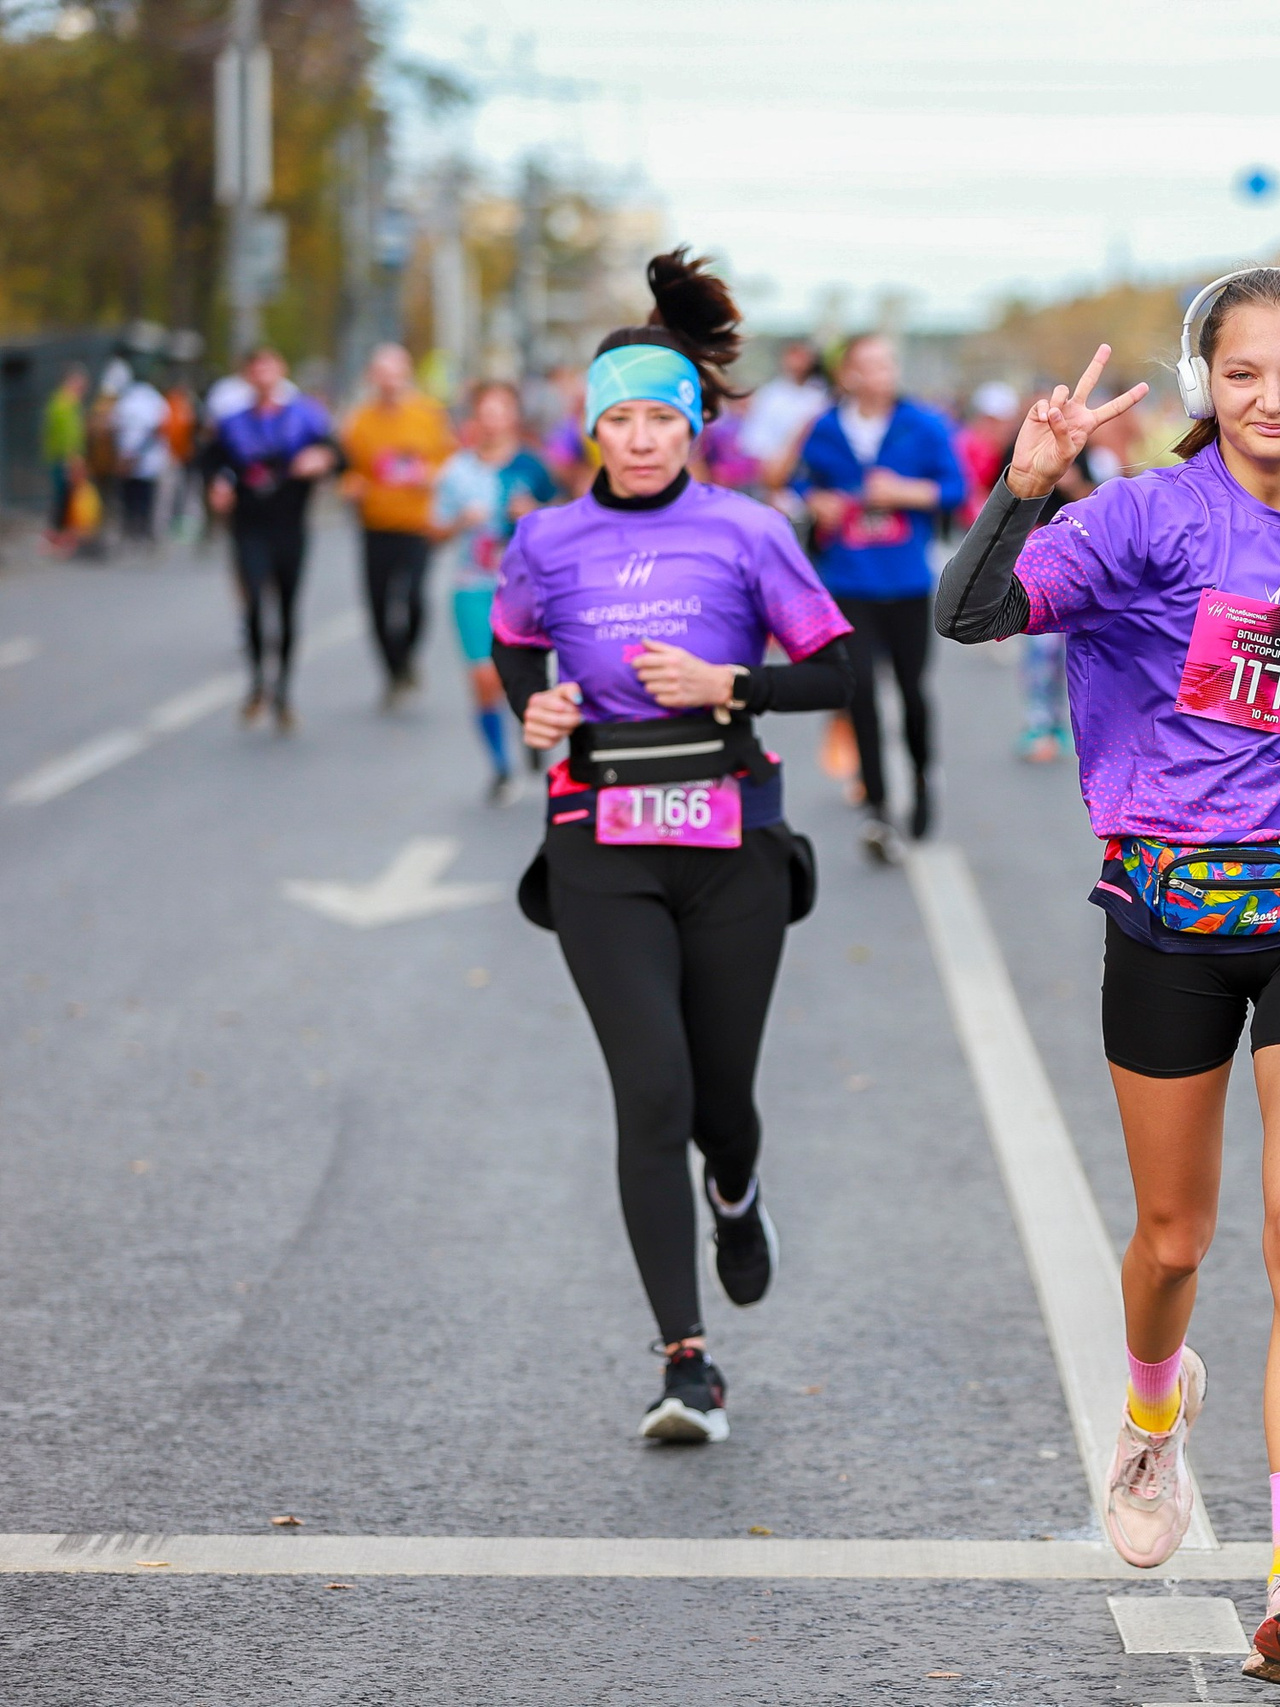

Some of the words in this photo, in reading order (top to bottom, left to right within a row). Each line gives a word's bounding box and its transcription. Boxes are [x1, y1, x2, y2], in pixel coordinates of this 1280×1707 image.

[1231, 640, 1239, 650] В
[1237, 629, 1273, 645] ВПИШИ
[1251, 708, 1262, 720] 10
[629, 787, 712, 829] 1766
[1240, 909, 1278, 925] Sport
